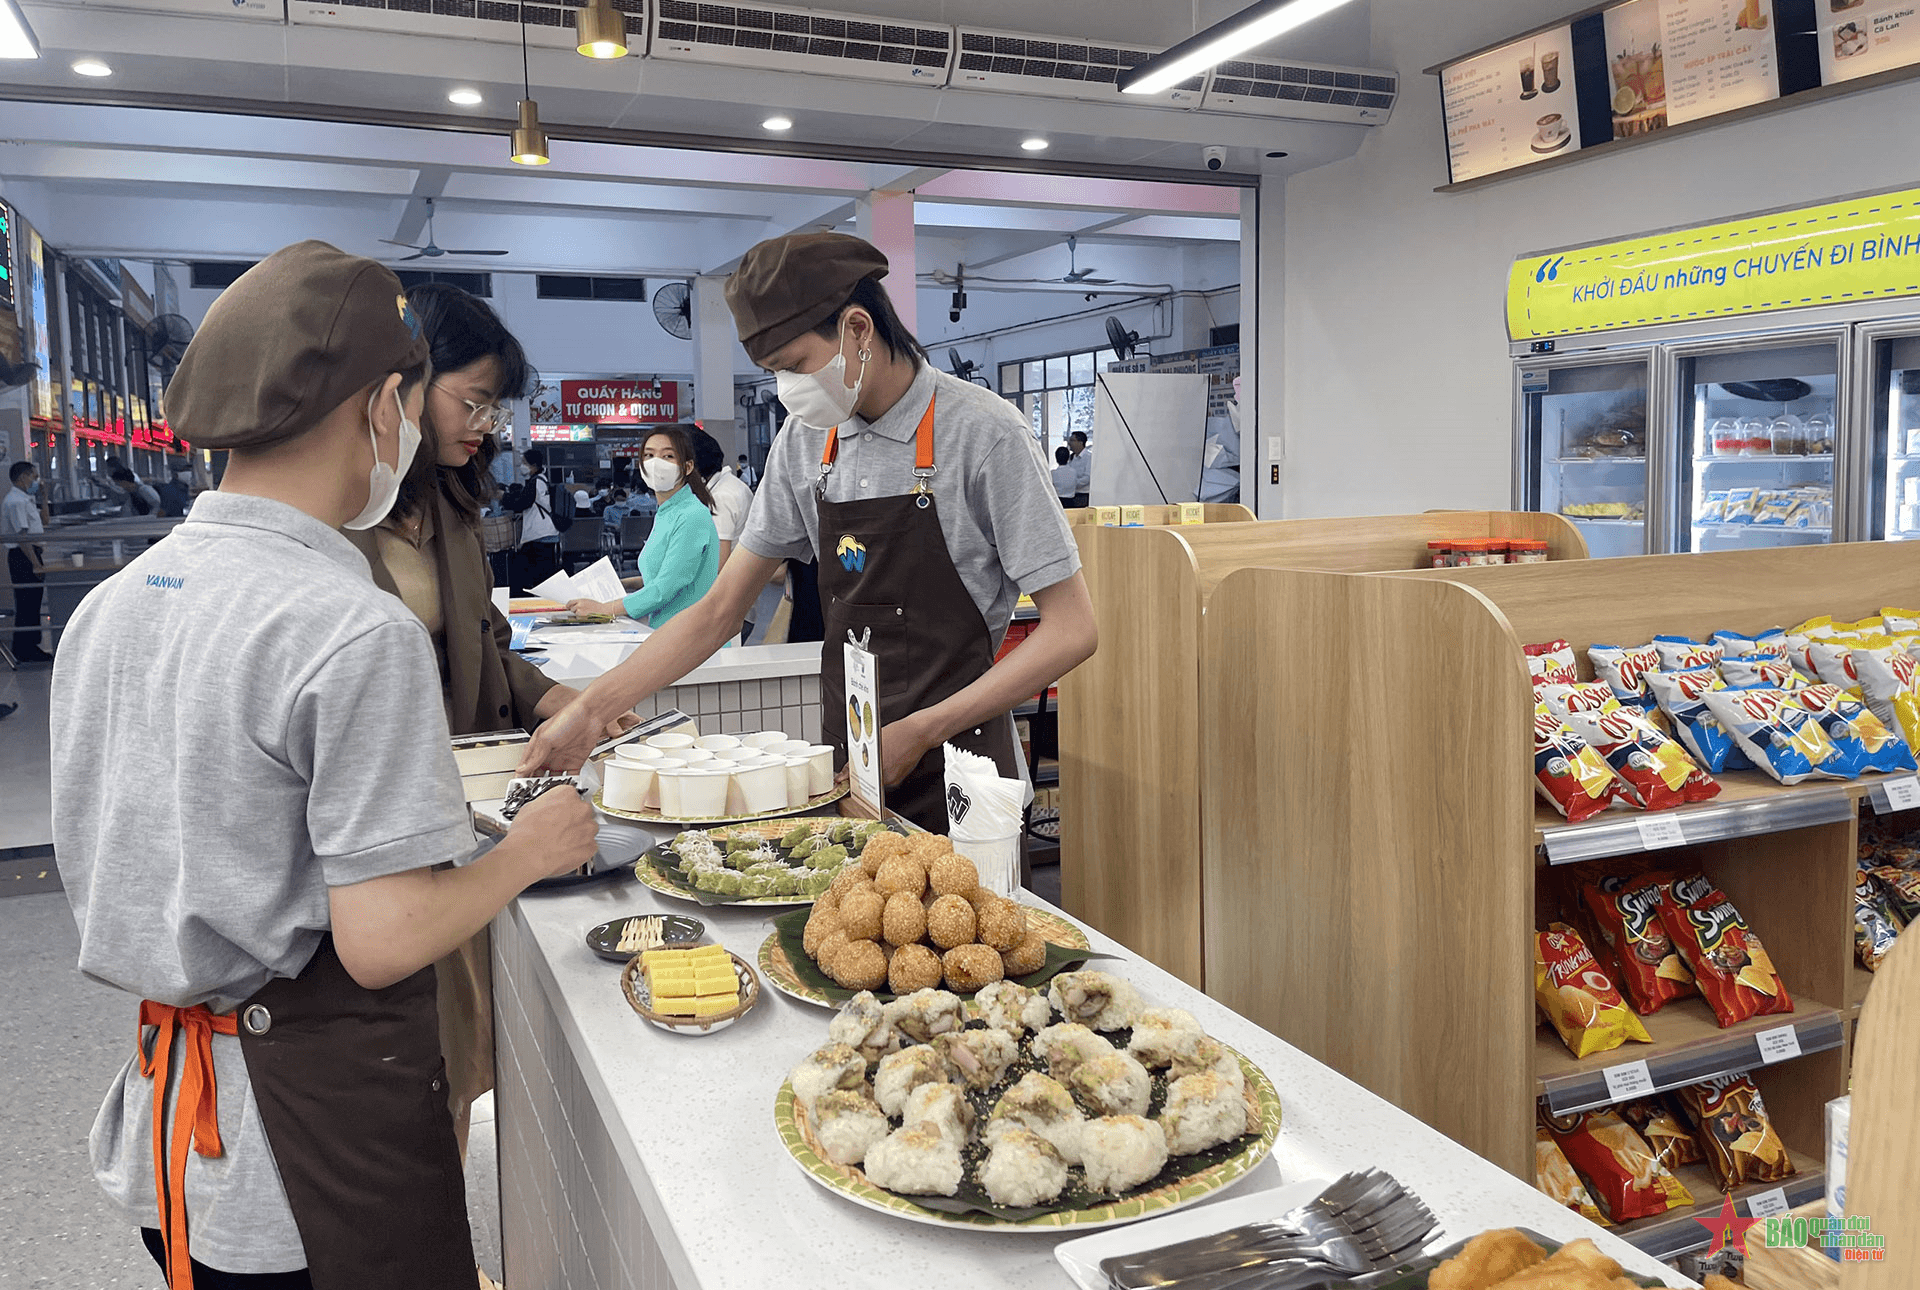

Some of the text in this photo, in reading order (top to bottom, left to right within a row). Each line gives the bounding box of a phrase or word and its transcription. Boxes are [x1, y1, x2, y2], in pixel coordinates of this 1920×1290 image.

[1572, 232, 1920, 304] KHỞI ĐẦU những CHUYẾN ĐI BÌNH
[566, 402, 675, 419] TỰ CHỌN & DỊCH VỤ
[145, 574, 185, 590] VANVAN
[1622, 885, 1664, 930] Swing
[1694, 902, 1743, 940] Swing
